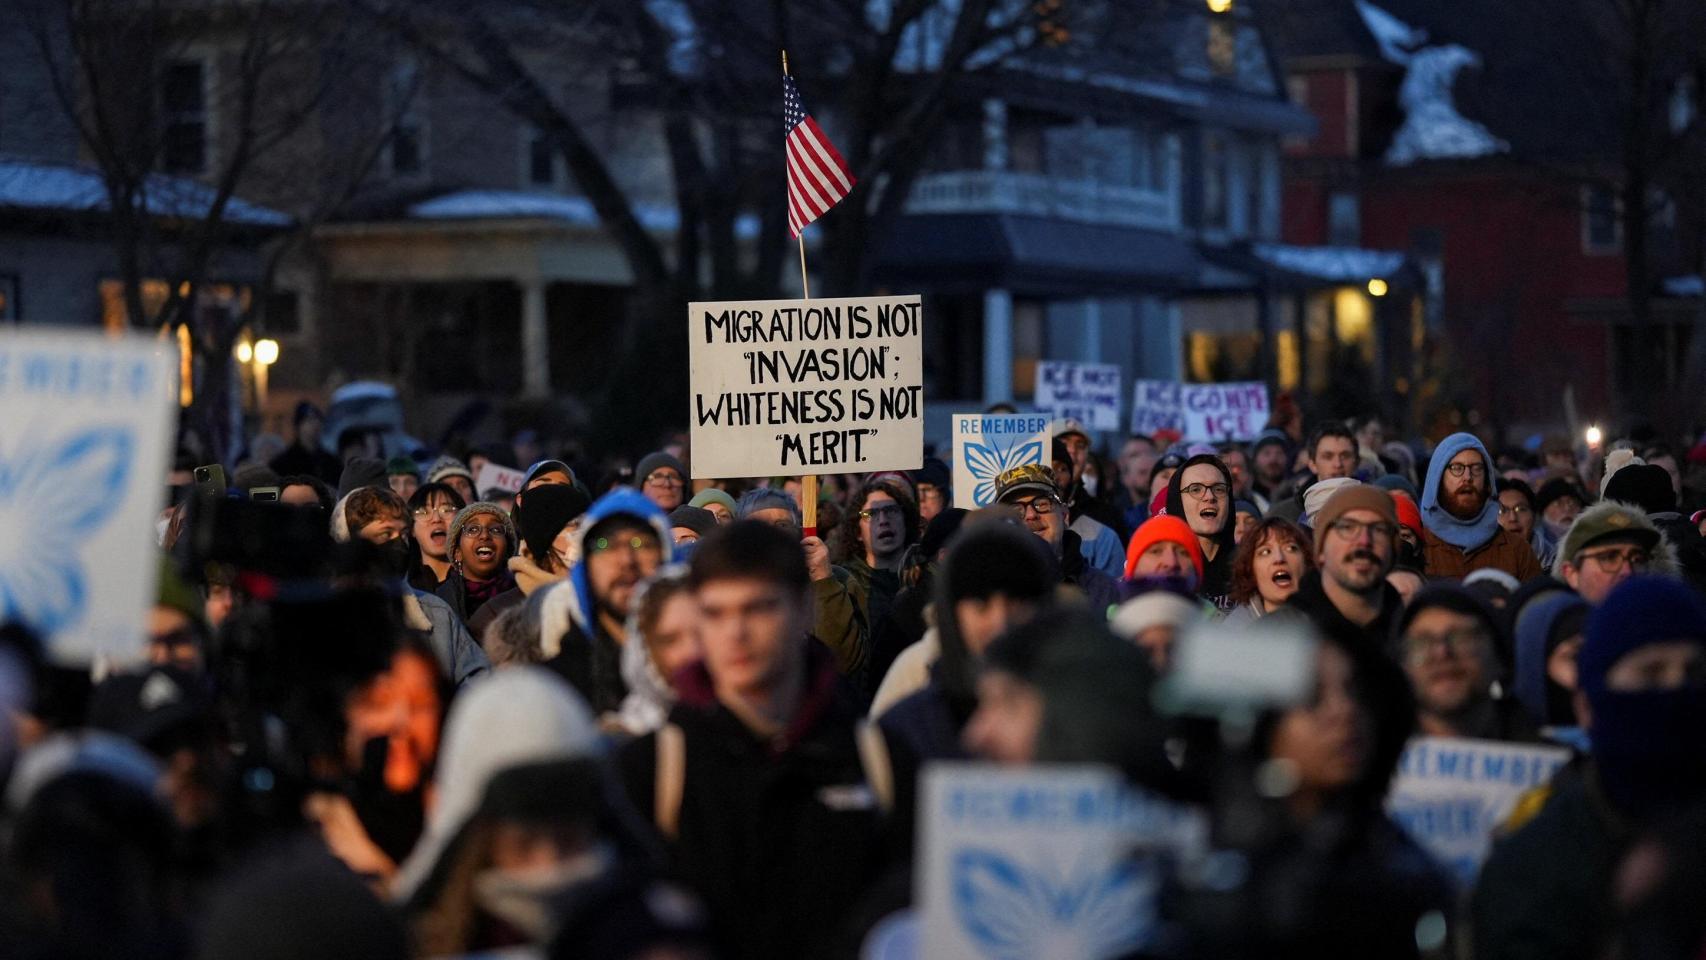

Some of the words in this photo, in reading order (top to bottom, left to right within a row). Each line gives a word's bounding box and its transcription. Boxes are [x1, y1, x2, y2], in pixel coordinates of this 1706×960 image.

[705, 307, 840, 343] MIGRATION
[848, 305, 872, 339] IS
[877, 303, 921, 338] NOT
[696, 389, 845, 426] WHITENESS
[851, 388, 875, 421] IS
[880, 386, 922, 421] NOT
[960, 418, 1046, 434] REMEMBER
